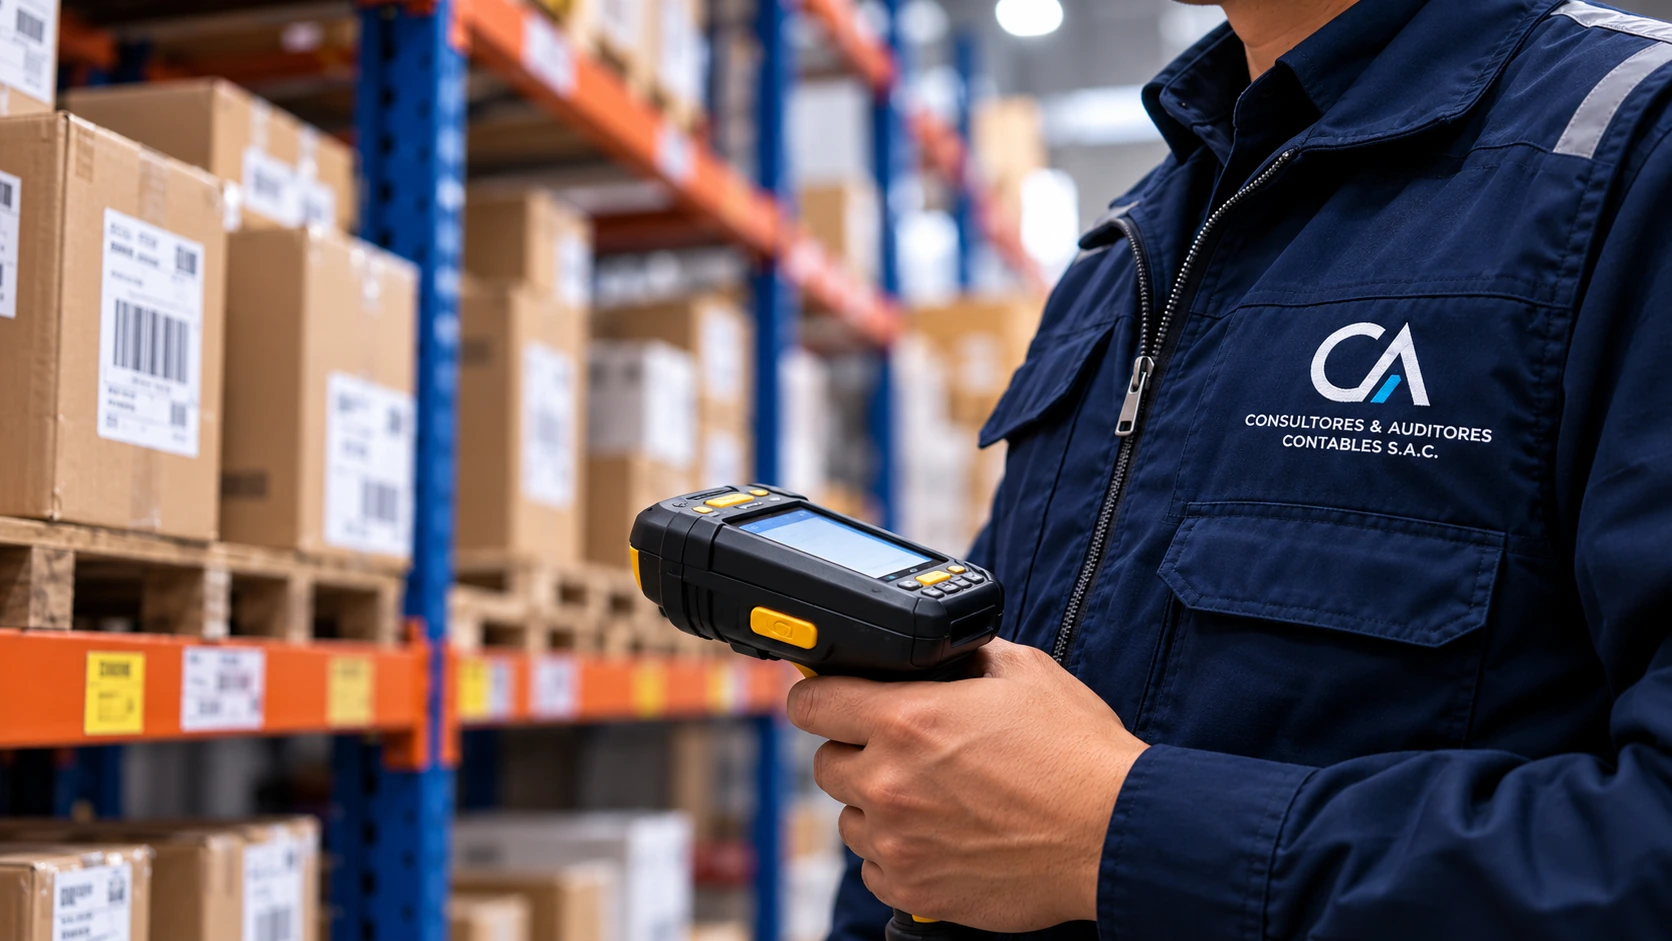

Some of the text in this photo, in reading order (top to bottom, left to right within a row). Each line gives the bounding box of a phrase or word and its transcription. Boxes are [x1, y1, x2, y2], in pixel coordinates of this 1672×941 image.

[1311, 322, 1430, 407] CA
[1245, 413, 1493, 443] CONSULTORES & AUDITORES
[1282, 434, 1439, 459] CONTABLES S.A.C.
